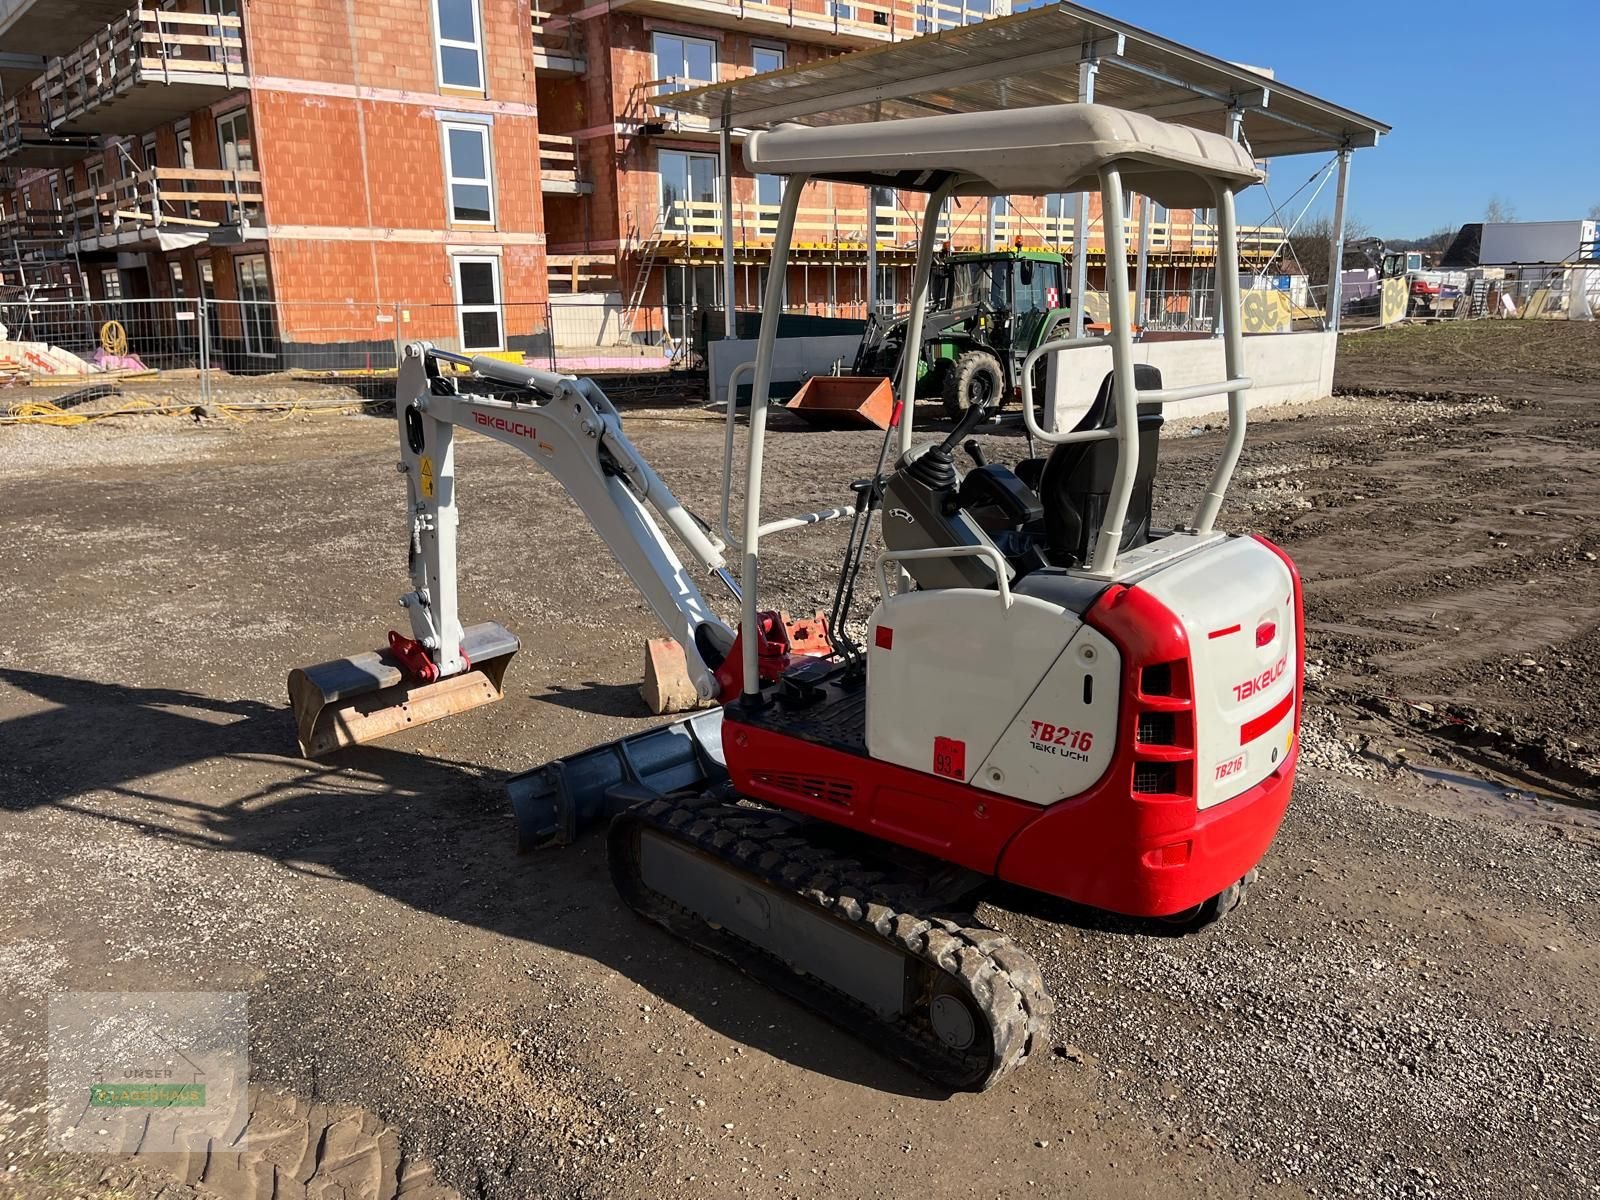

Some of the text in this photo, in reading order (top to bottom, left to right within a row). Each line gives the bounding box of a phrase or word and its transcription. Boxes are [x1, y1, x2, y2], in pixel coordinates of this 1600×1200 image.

[1030, 720, 1094, 752] TB216
[936, 752, 952, 774] 93
[1214, 756, 1243, 780] TB216
